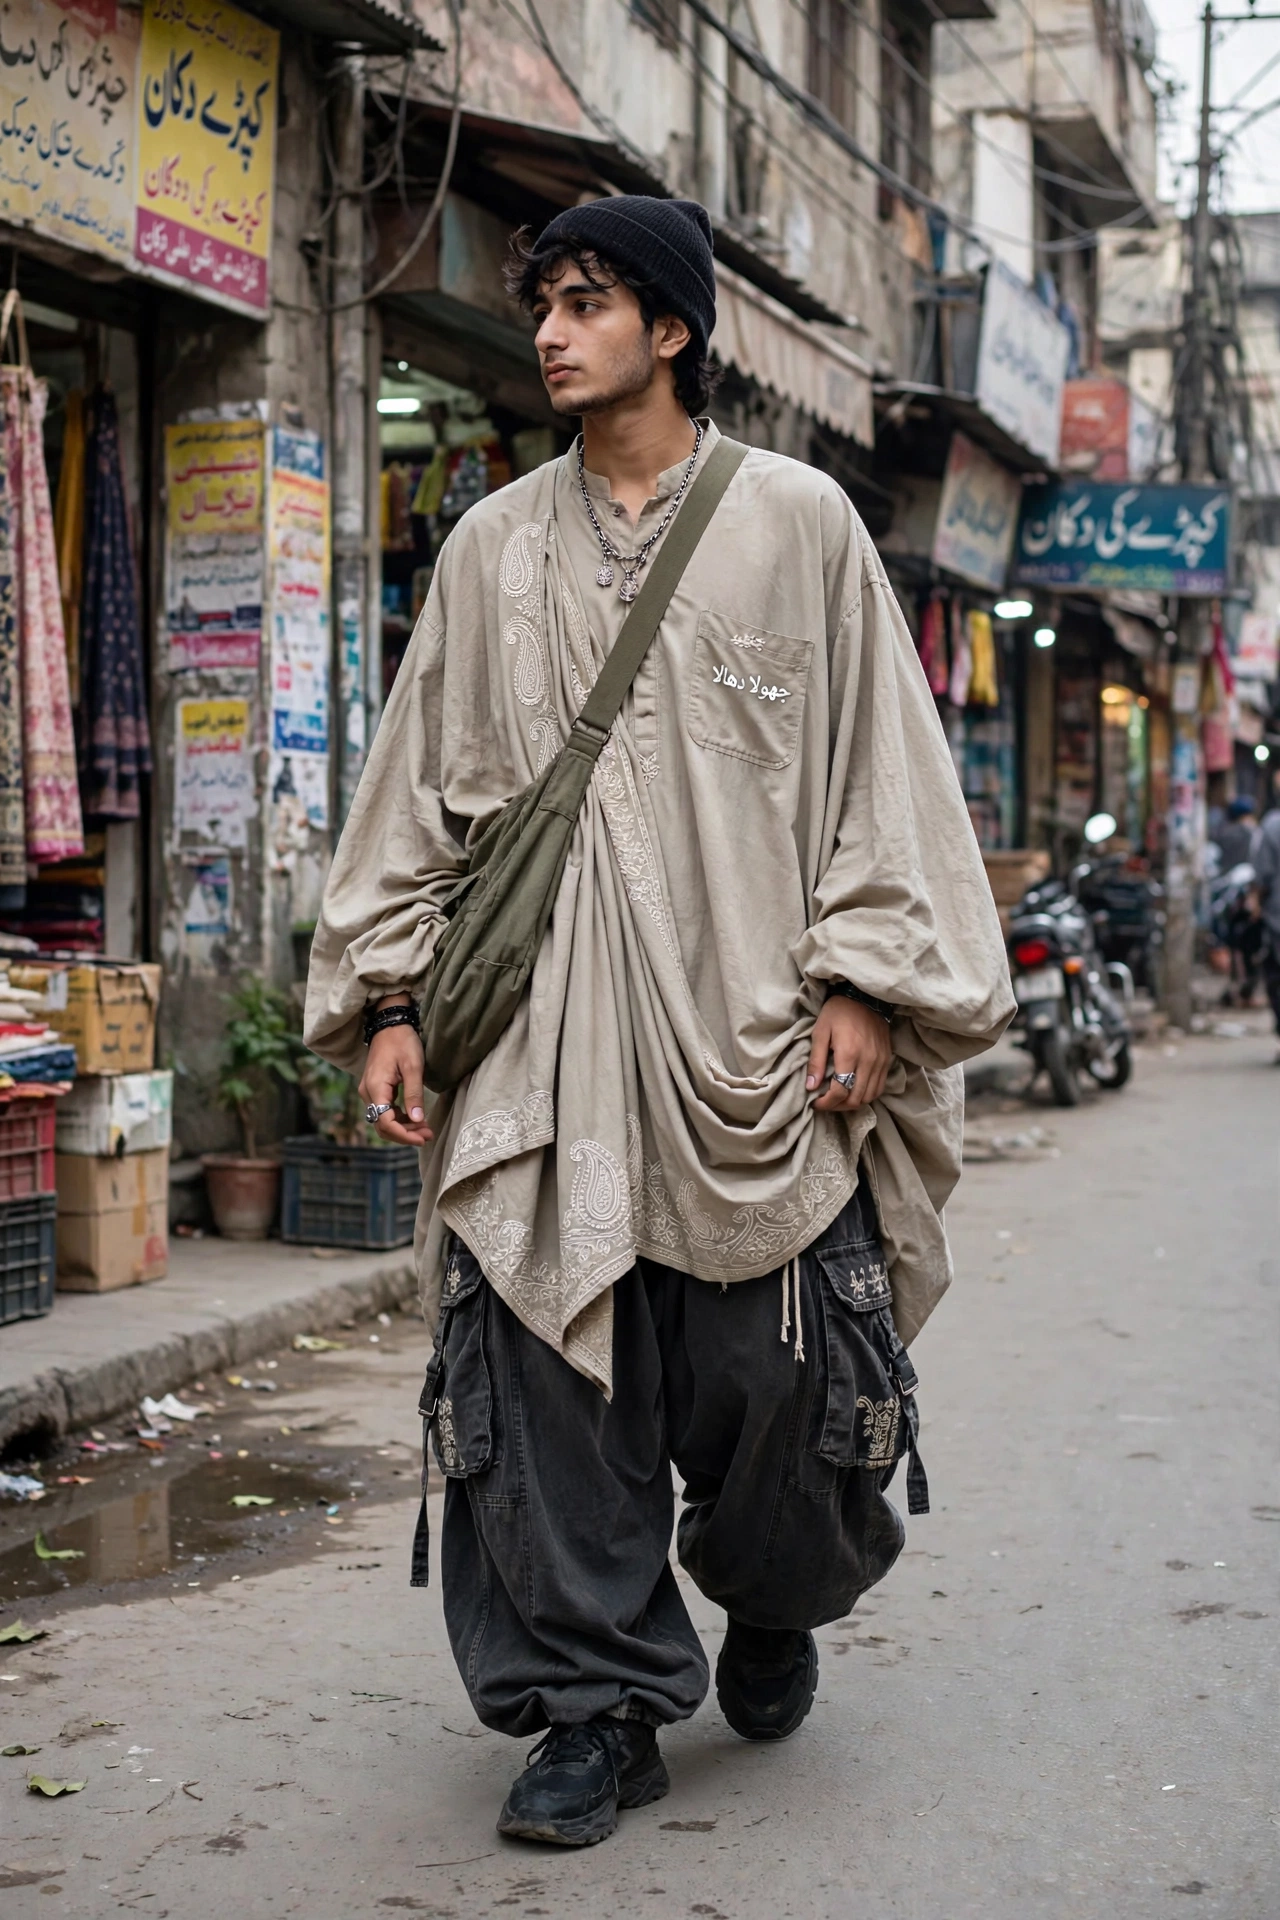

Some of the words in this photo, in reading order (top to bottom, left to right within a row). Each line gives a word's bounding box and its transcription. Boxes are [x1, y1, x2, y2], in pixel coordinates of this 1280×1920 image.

[143, 46, 196, 130] دکان
[200, 78, 271, 172] کپڑے
[1021, 492, 1095, 557] دکان
[1094, 486, 1140, 560] کی
[1126, 493, 1226, 569] کپڑے
